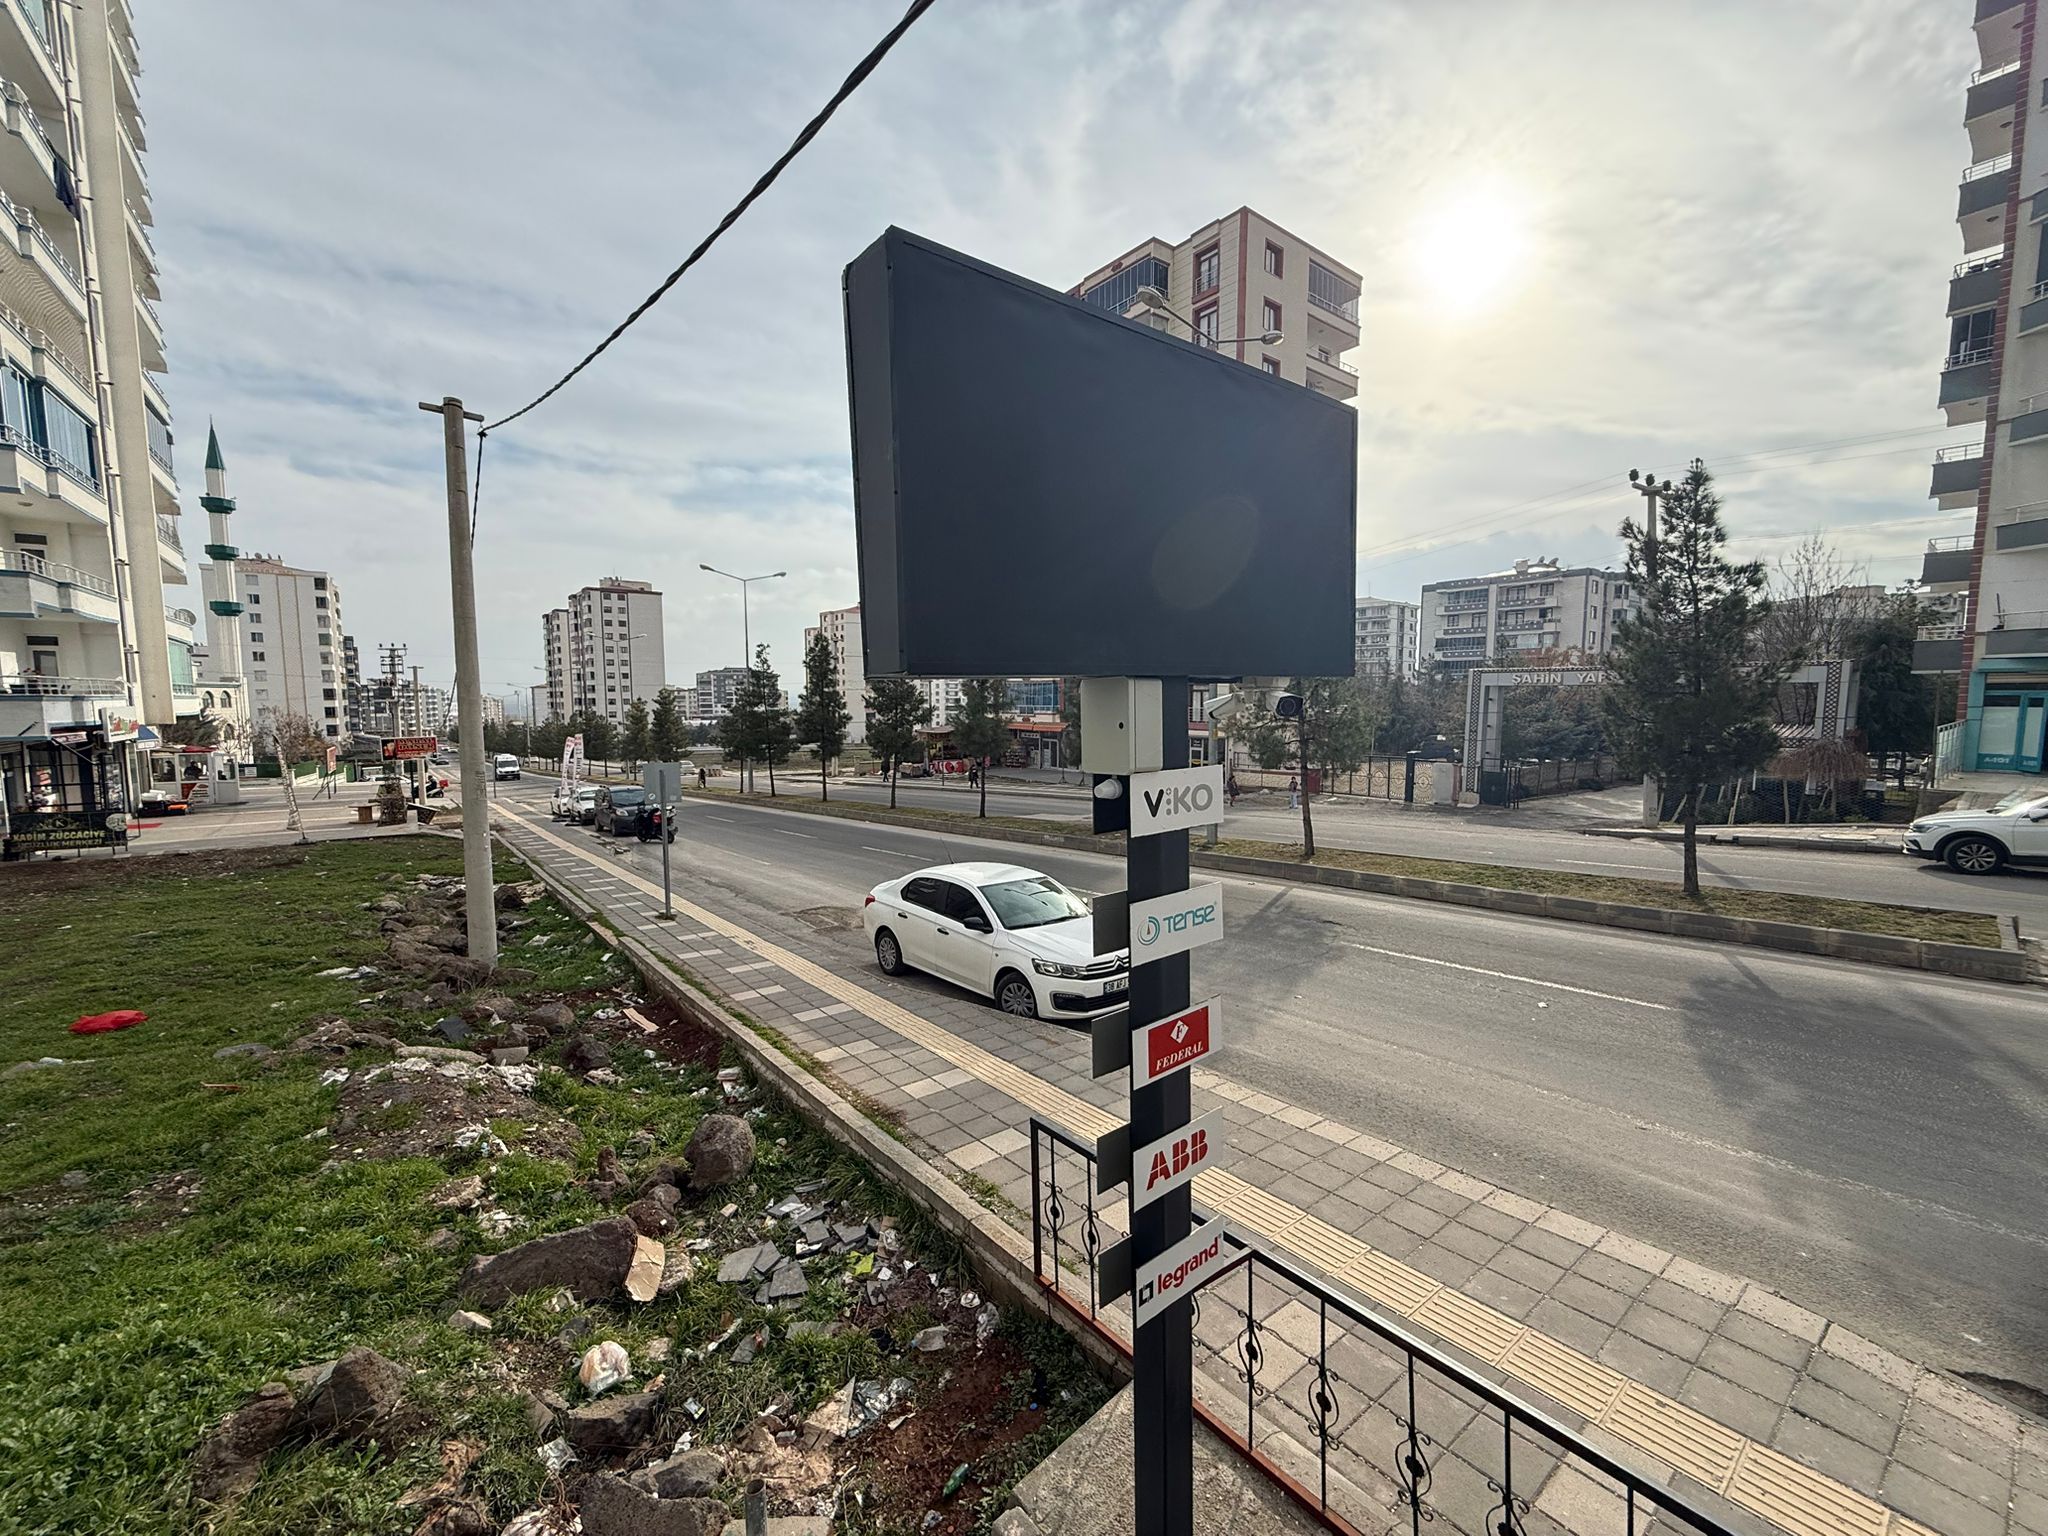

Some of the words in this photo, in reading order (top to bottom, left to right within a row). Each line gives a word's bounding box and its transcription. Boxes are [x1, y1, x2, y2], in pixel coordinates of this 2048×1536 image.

[1512, 672, 1561, 685] ŞAHİN
[1156, 1040, 1204, 1072] FEDERAL
[1146, 1129, 1209, 1192] ABB
[1157, 1235, 1219, 1295] legrand
